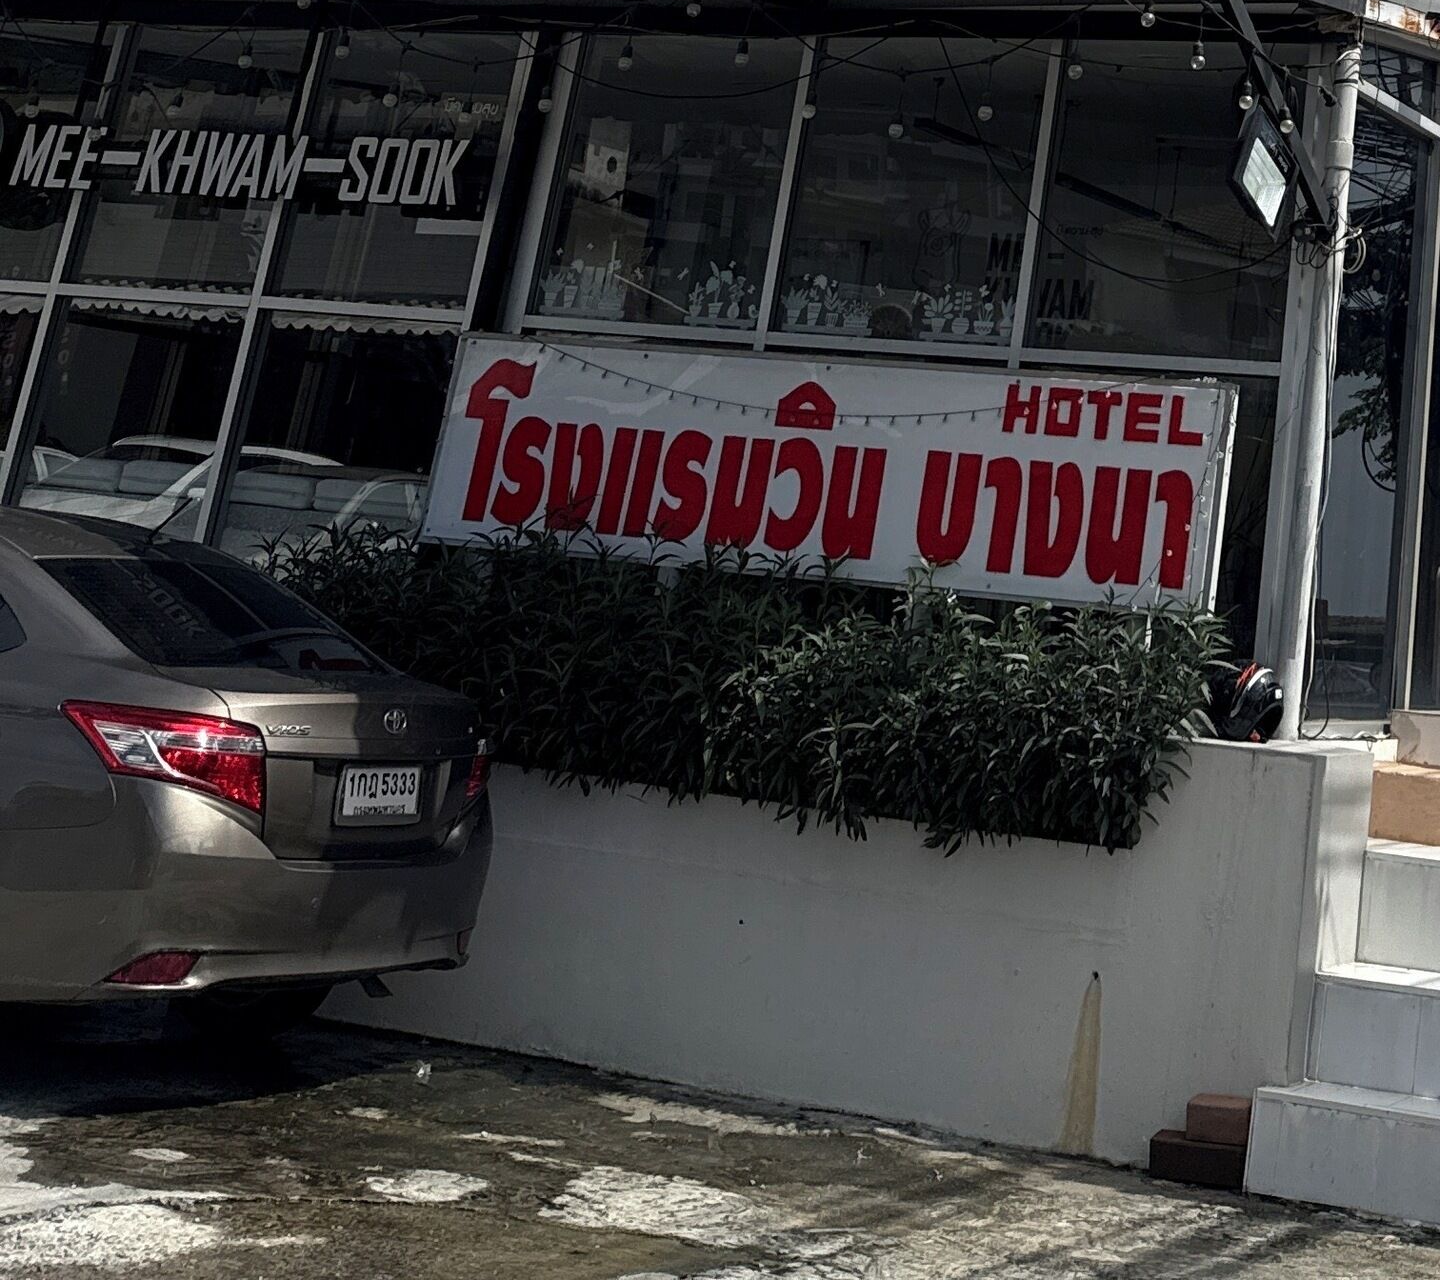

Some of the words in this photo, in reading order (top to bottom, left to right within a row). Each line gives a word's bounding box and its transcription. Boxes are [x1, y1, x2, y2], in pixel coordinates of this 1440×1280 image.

[1003, 380, 1205, 446] HOTEL
[462, 359, 887, 561] โรงแรมวิน
[915, 451, 1193, 591] บางนา
[265, 724, 312, 736] VIOS
[381, 772, 416, 797] 5333
